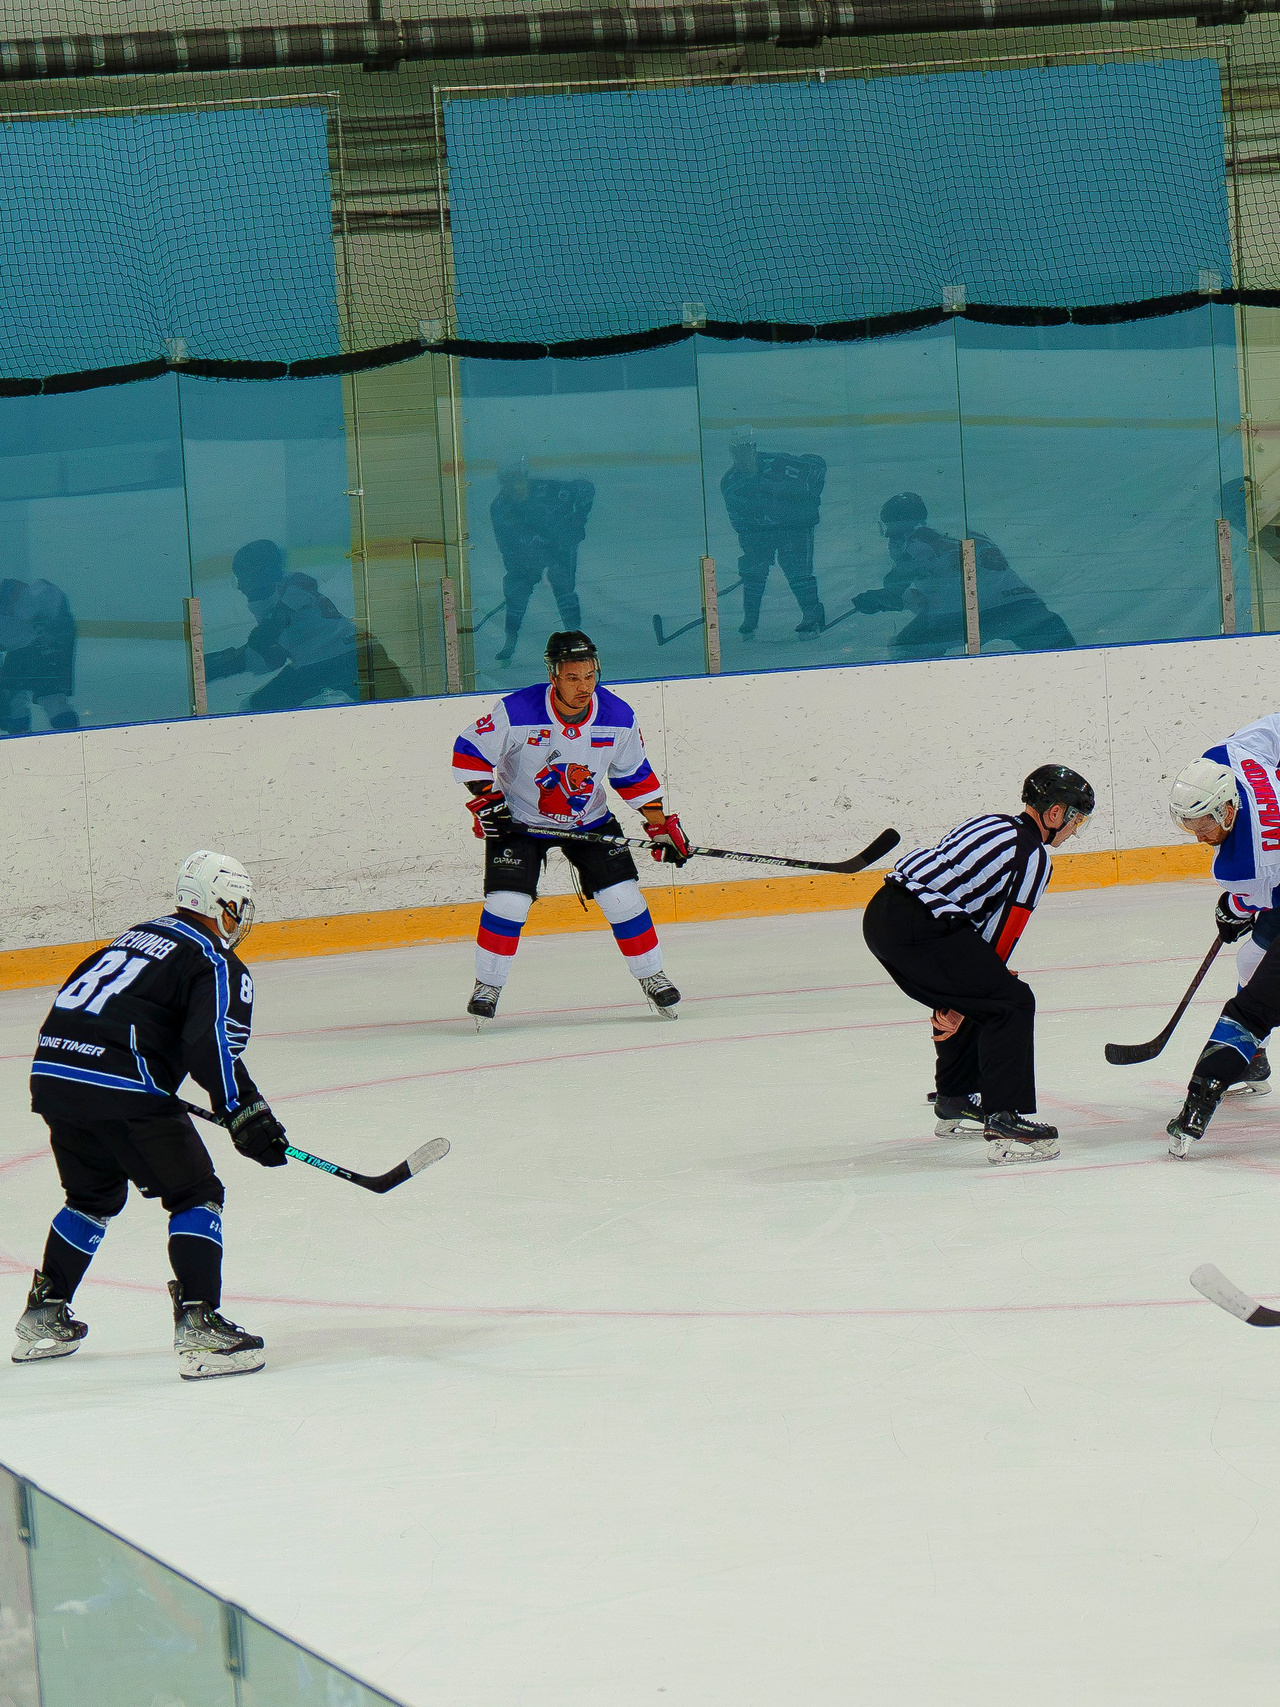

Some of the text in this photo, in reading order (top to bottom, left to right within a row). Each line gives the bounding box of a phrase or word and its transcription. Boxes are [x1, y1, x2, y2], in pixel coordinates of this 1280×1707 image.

[480, 801, 508, 816] CC
[750, 856, 788, 866] TIMER
[55, 950, 151, 1015] 81
[40, 1036, 105, 1057] ONE TIMER
[284, 1146, 338, 1174] ONE TIMER
